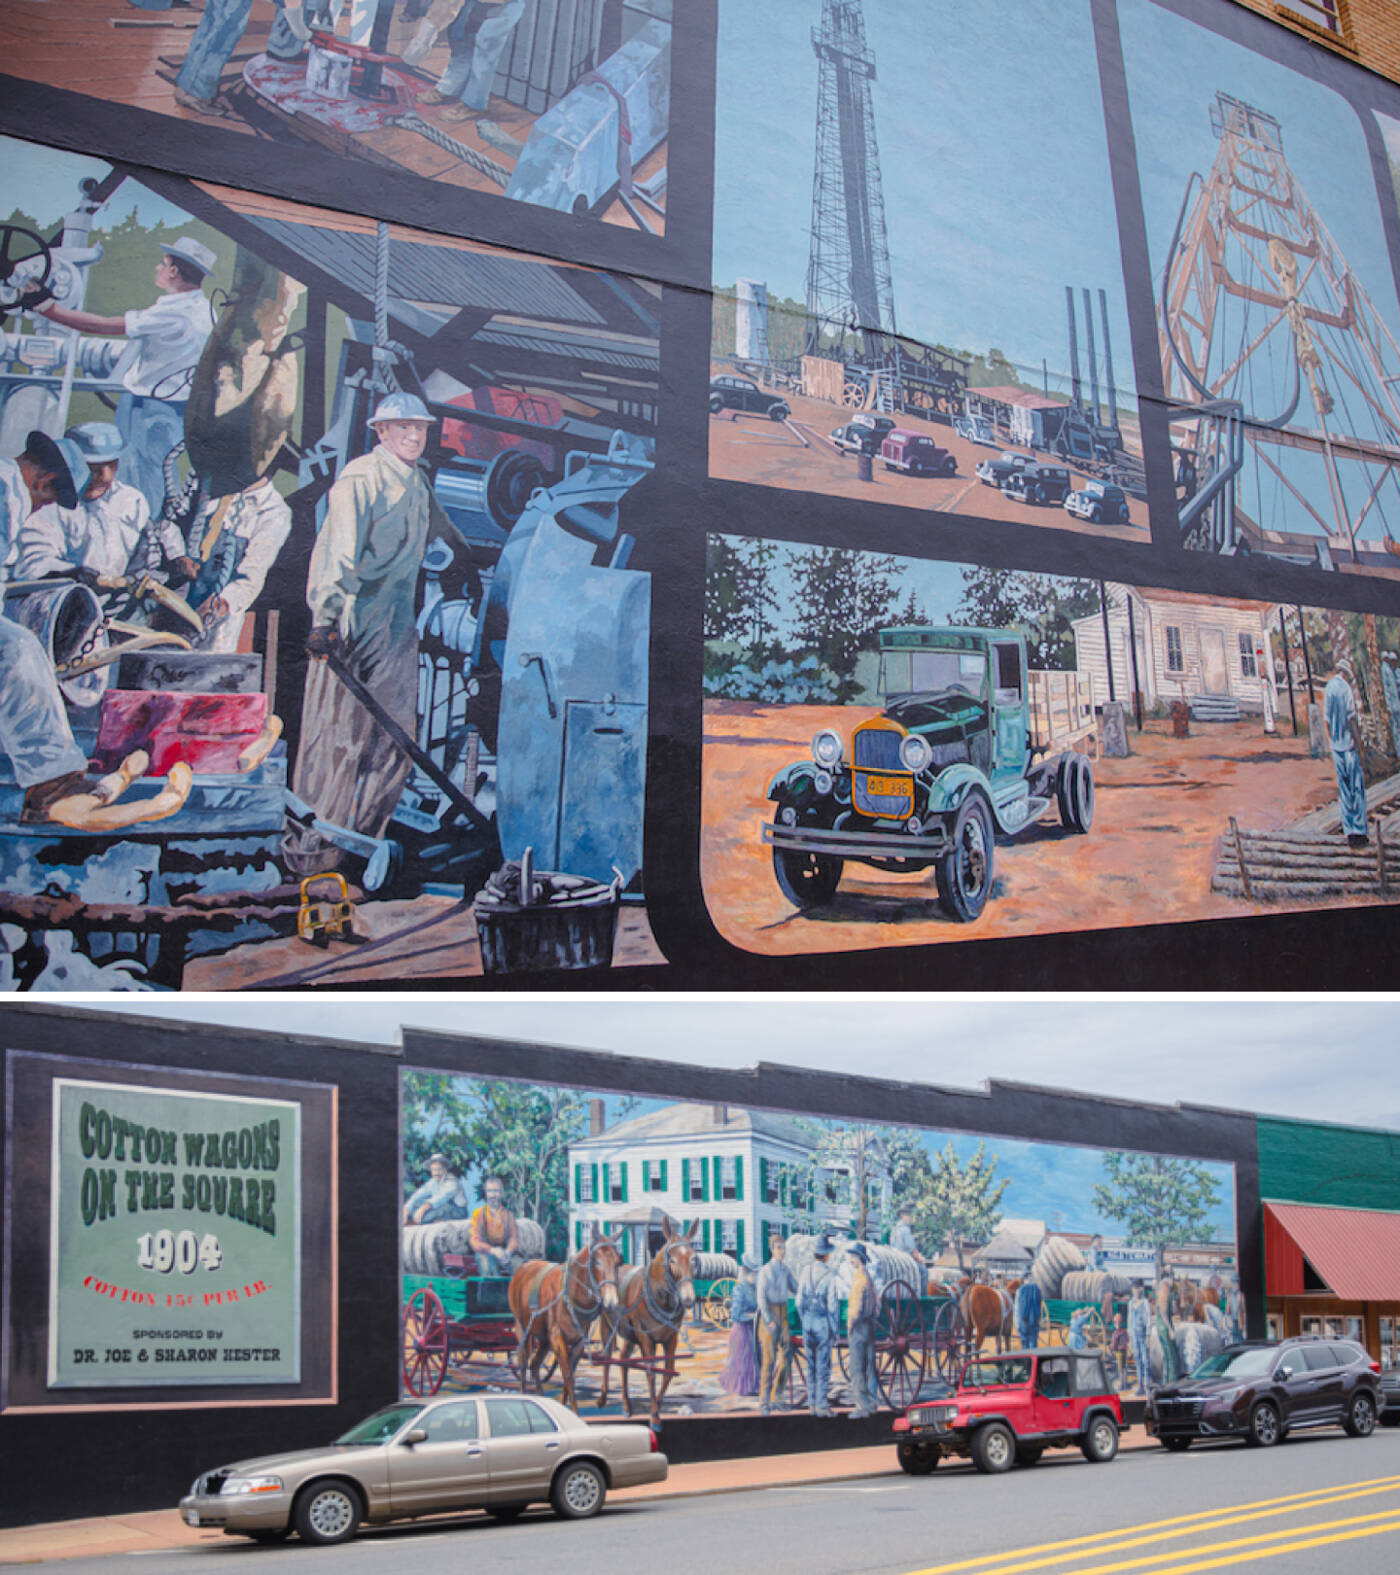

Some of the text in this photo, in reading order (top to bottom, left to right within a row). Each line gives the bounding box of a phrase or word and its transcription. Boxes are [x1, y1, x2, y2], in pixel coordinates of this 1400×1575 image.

[80, 1101, 280, 1171] COTTON WAGONS
[81, 1167, 276, 1237] ON THE SQUARE
[137, 1229, 222, 1274] 1904
[84, 1275, 155, 1307] COTTON
[204, 1289, 239, 1306] PER
[132, 1330, 223, 1340] SPONSORED BY
[73, 1349, 281, 1363] DR. JOE & SHARON HESTER
